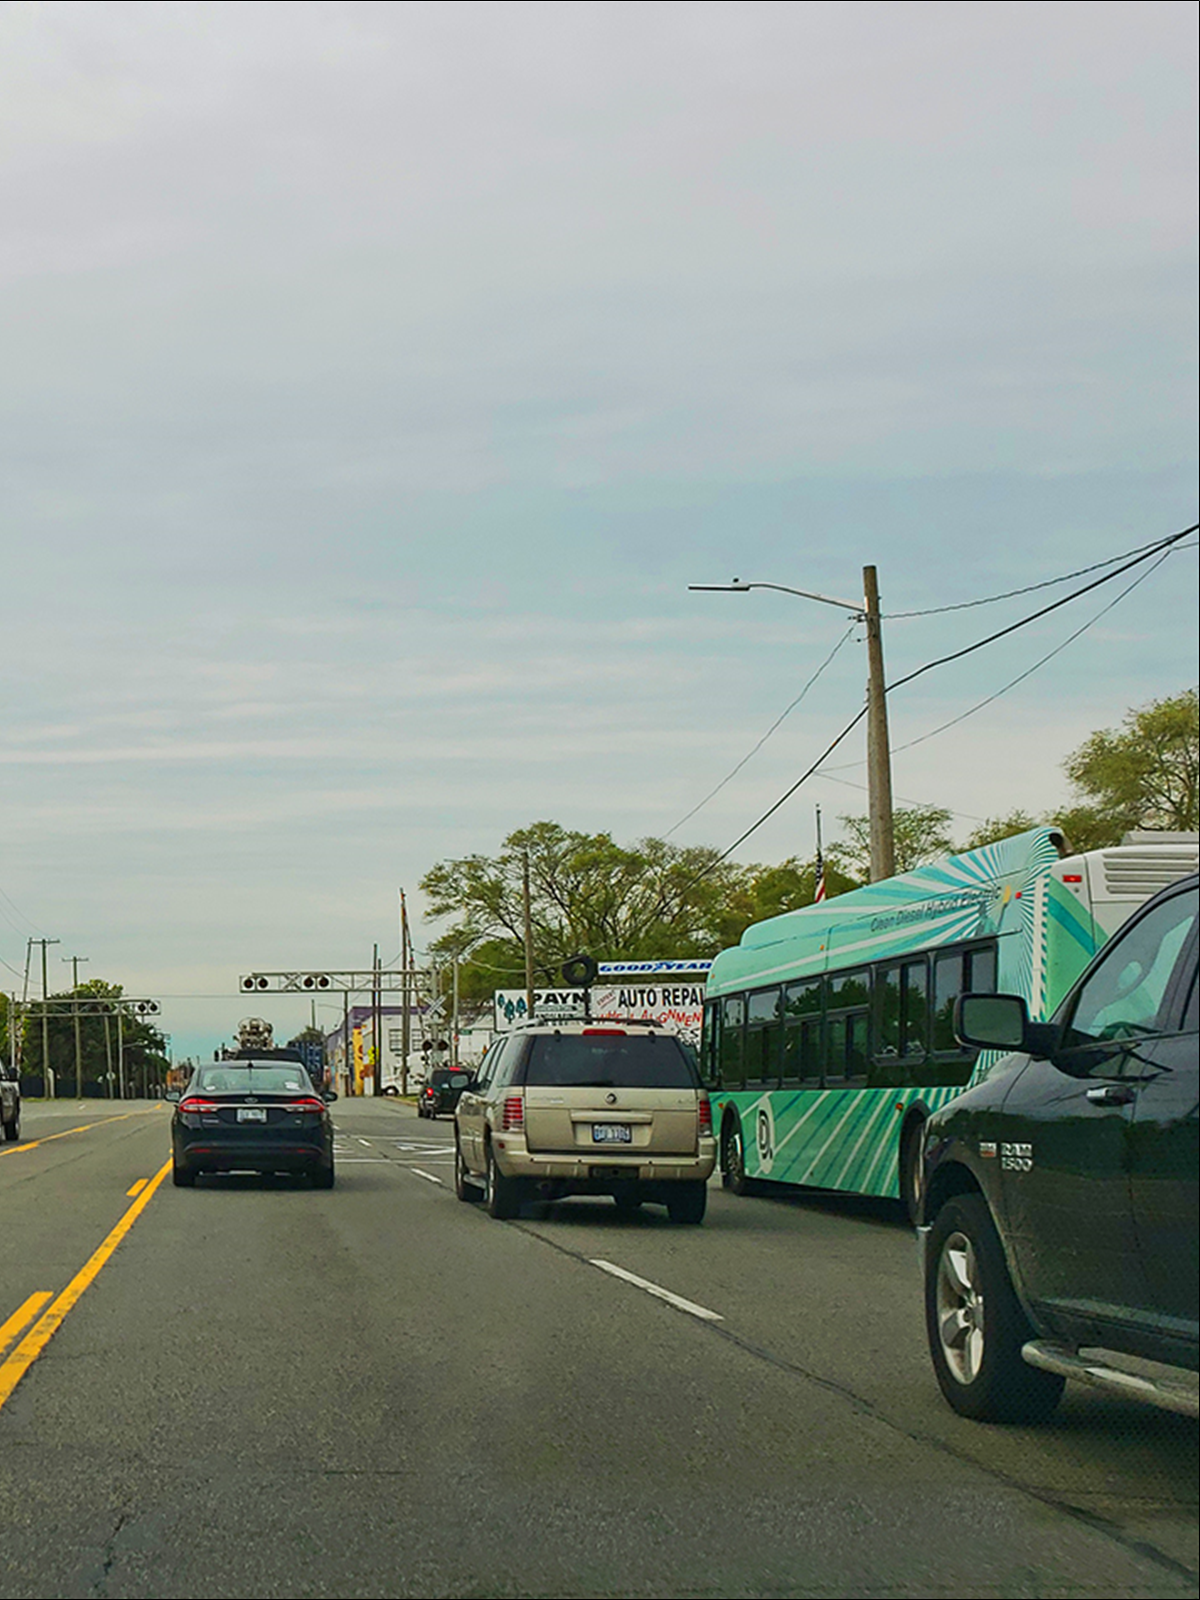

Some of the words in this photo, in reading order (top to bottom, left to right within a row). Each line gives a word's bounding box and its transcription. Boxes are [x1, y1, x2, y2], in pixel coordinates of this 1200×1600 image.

[599, 961, 712, 973] GOODYEAR
[532, 992, 587, 1004] PAYN
[618, 988, 657, 1008] AUTO
[662, 987, 704, 1006] REPAI
[1001, 1142, 1032, 1157] RAM
[1001, 1156, 1033, 1172] 1500
